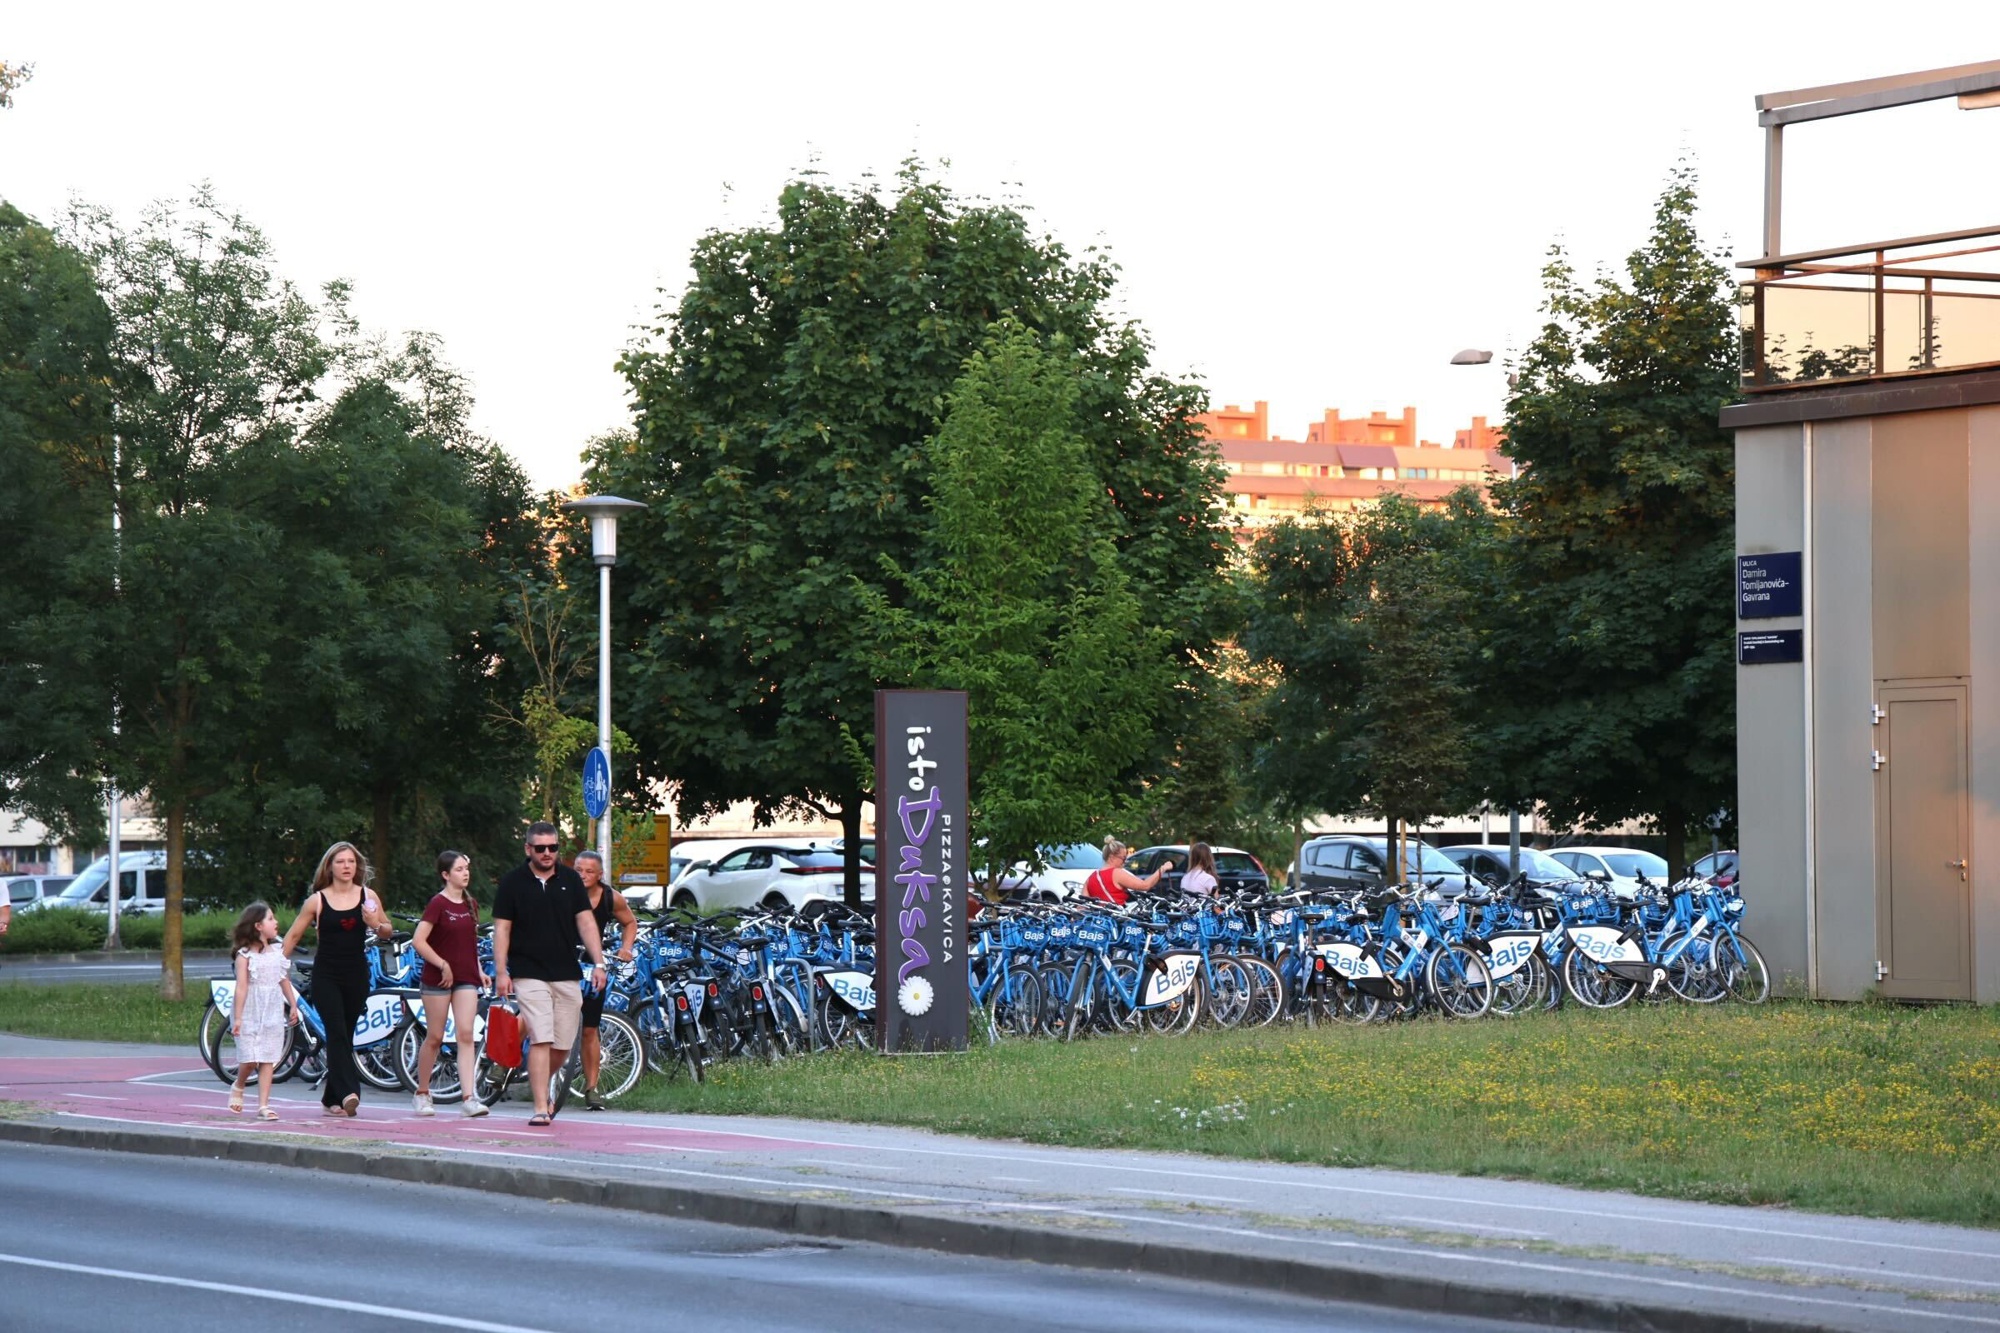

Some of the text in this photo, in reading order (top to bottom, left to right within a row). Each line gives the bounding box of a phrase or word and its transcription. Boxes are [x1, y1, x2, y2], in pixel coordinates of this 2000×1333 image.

[1742, 568, 1767, 579] Damira
[1742, 592, 1770, 602] Gavrana
[894, 726, 942, 986] isto Duksa
[941, 814, 953, 963] PIZZA KAVICA
[1571, 899, 1593, 910] Bajs
[1125, 926, 1142, 935] Bajs
[1228, 920, 1244, 930] Bajs
[1024, 931, 1045, 940] Bajs
[1051, 926, 1071, 938] Bajs
[1078, 931, 1104, 941] Bajs
[659, 946, 683, 956] Bajs
[1575, 933, 1626, 960] Bajs
[1325, 950, 1369, 976] Bajs
[1156, 959, 1195, 995] Bajs
[213, 986, 233, 1009] Ba
